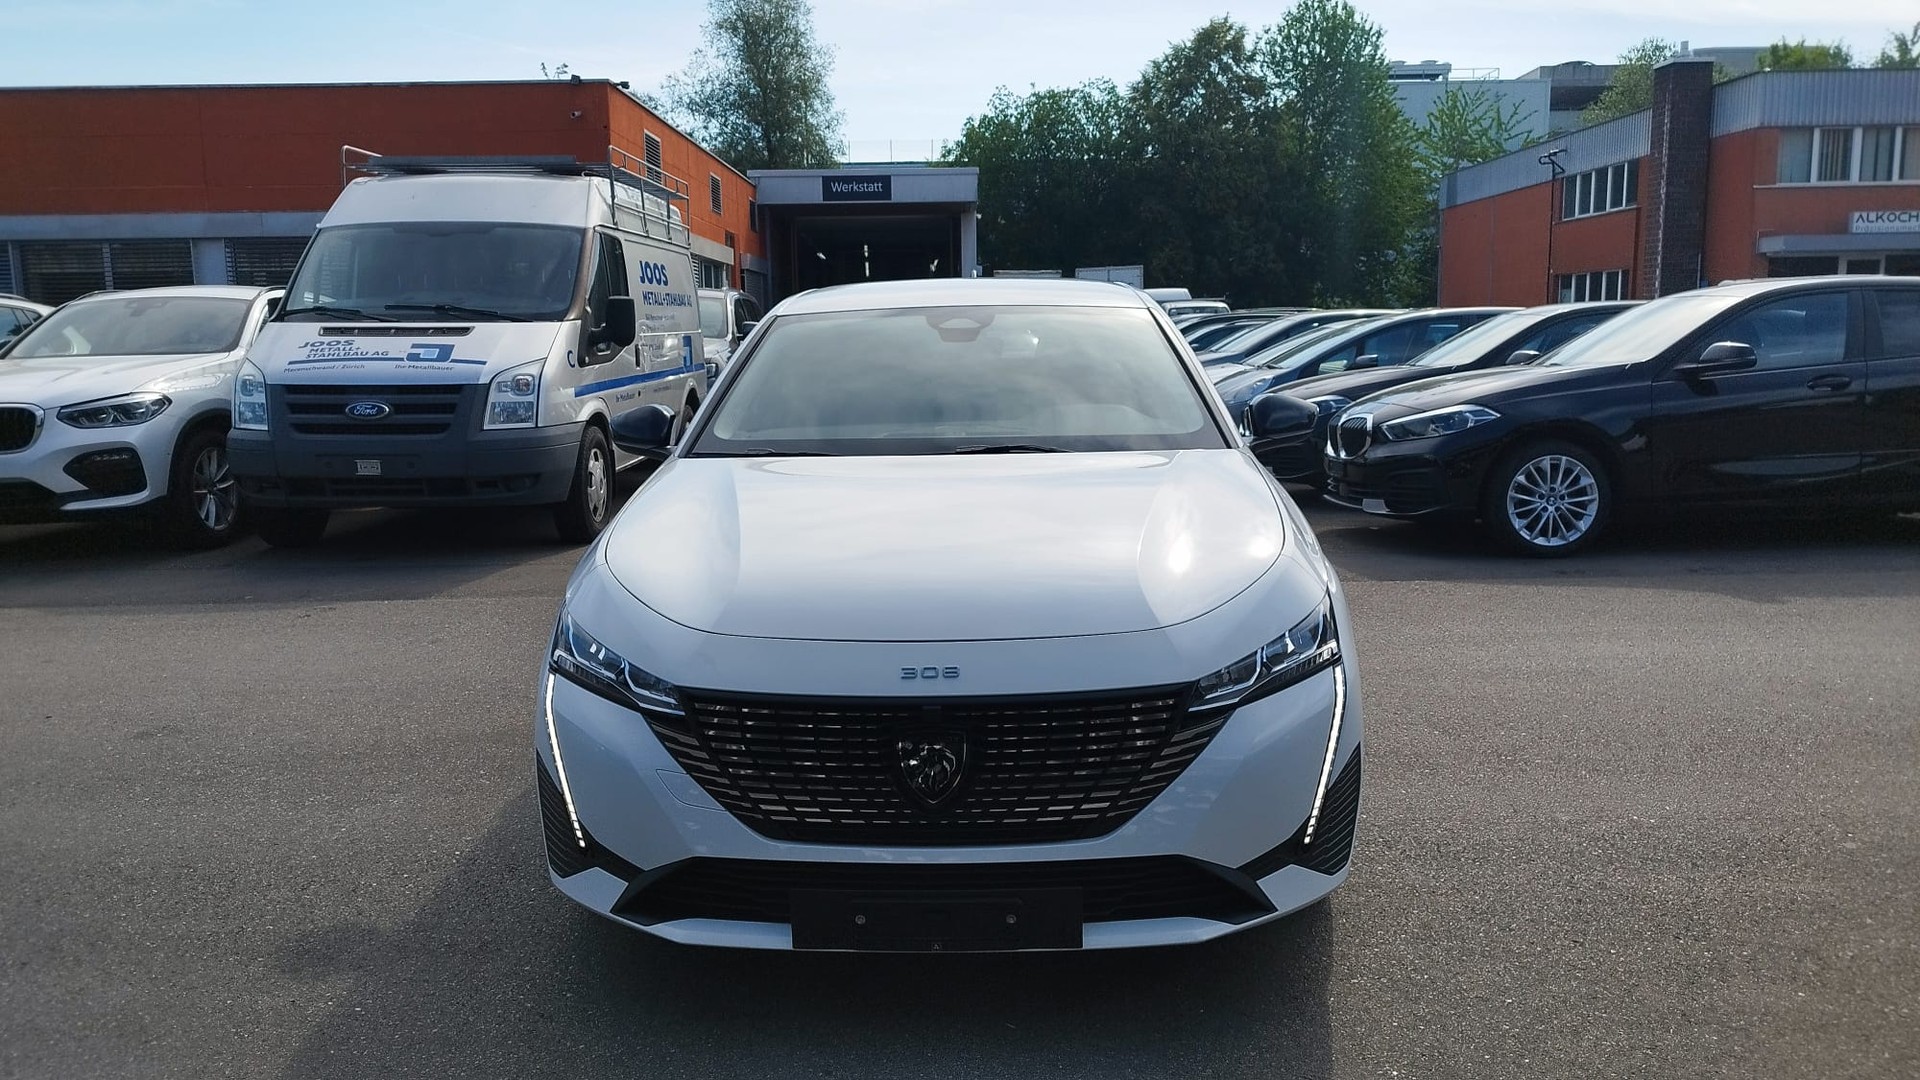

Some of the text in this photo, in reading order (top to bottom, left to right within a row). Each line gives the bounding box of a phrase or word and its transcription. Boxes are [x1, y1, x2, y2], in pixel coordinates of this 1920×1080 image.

[830, 181, 883, 192] Werkstatt
[1855, 212, 1920, 223] ALKOCH
[639, 260, 669, 286] JOOS
[298, 339, 355, 348] JOOS
[306, 351, 369, 359] STAHLBAU
[354, 404, 378, 415] Ford
[901, 666, 960, 680] 308
